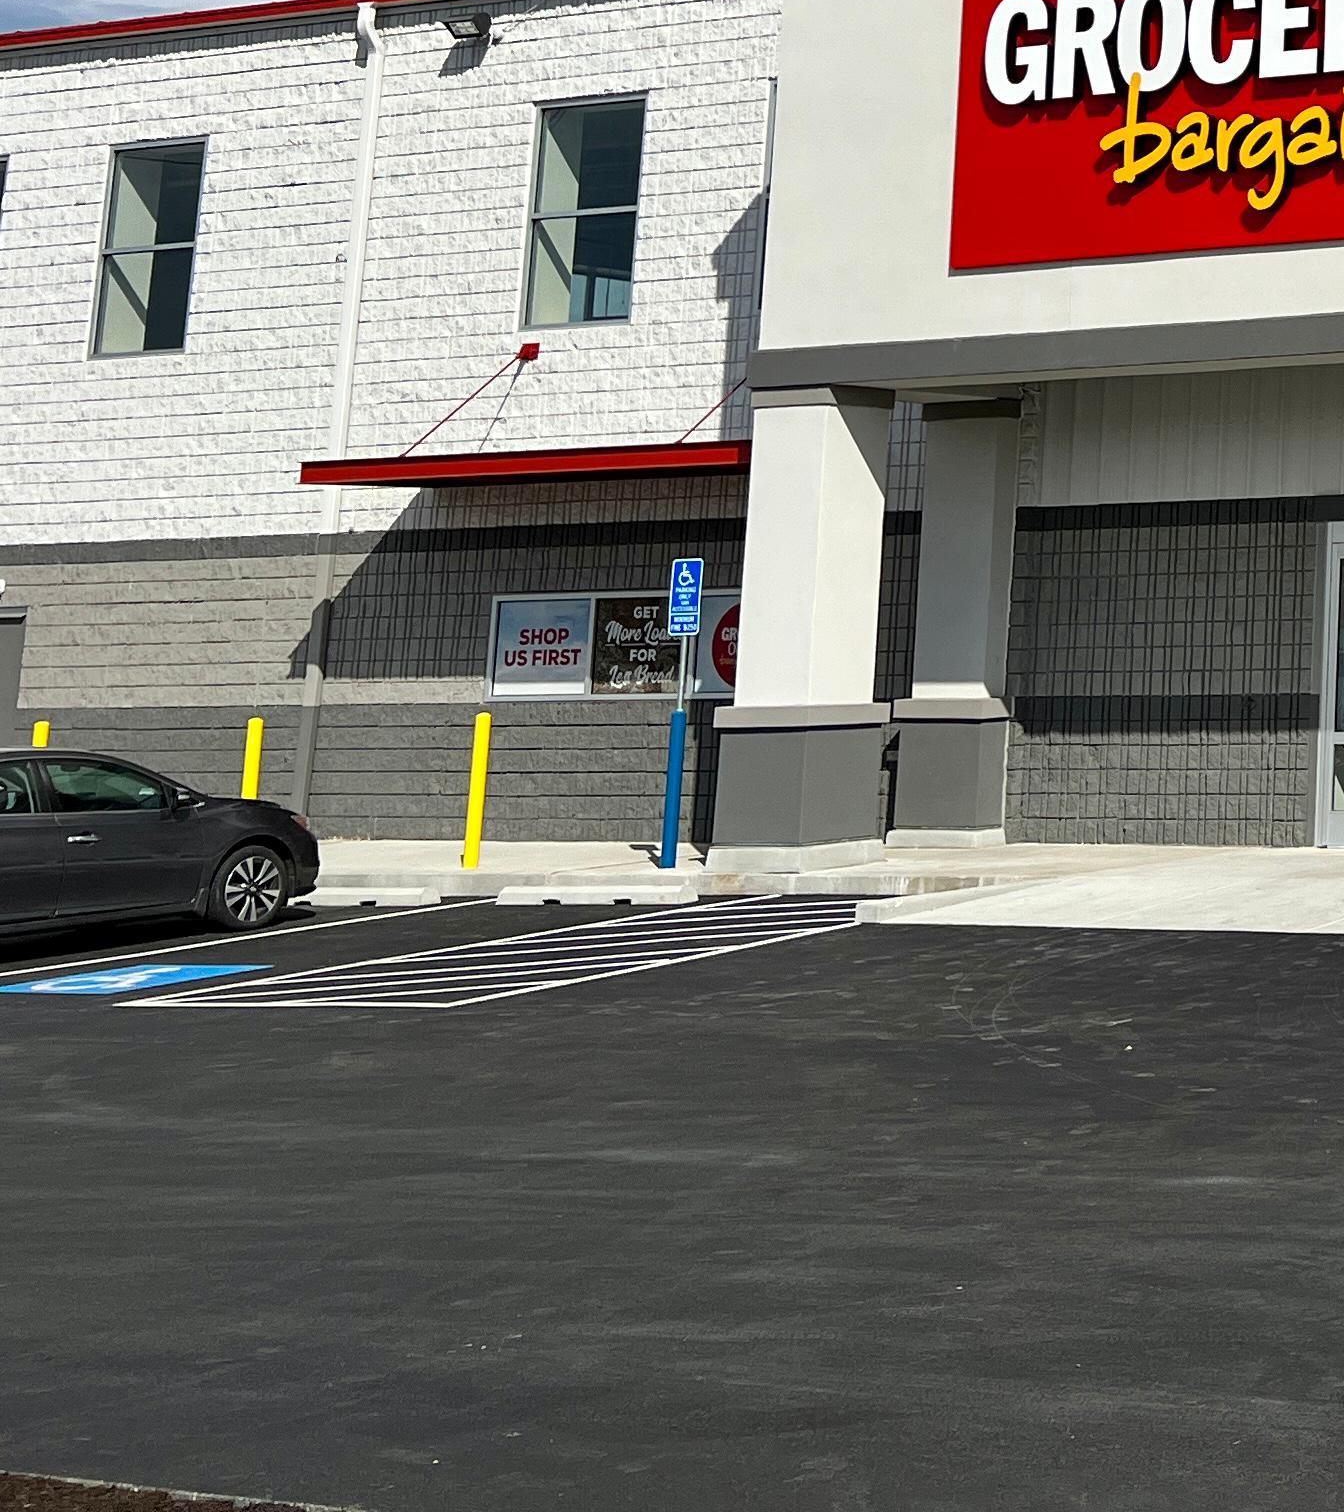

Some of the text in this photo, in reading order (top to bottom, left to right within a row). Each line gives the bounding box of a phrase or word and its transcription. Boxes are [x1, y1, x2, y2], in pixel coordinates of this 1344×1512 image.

[633, 605, 660, 620] GET
[518, 627, 571, 646] SHOP
[605, 619, 642, 646] More
[504, 648, 582, 667] US FIRST
[629, 648, 657, 662] FOR
